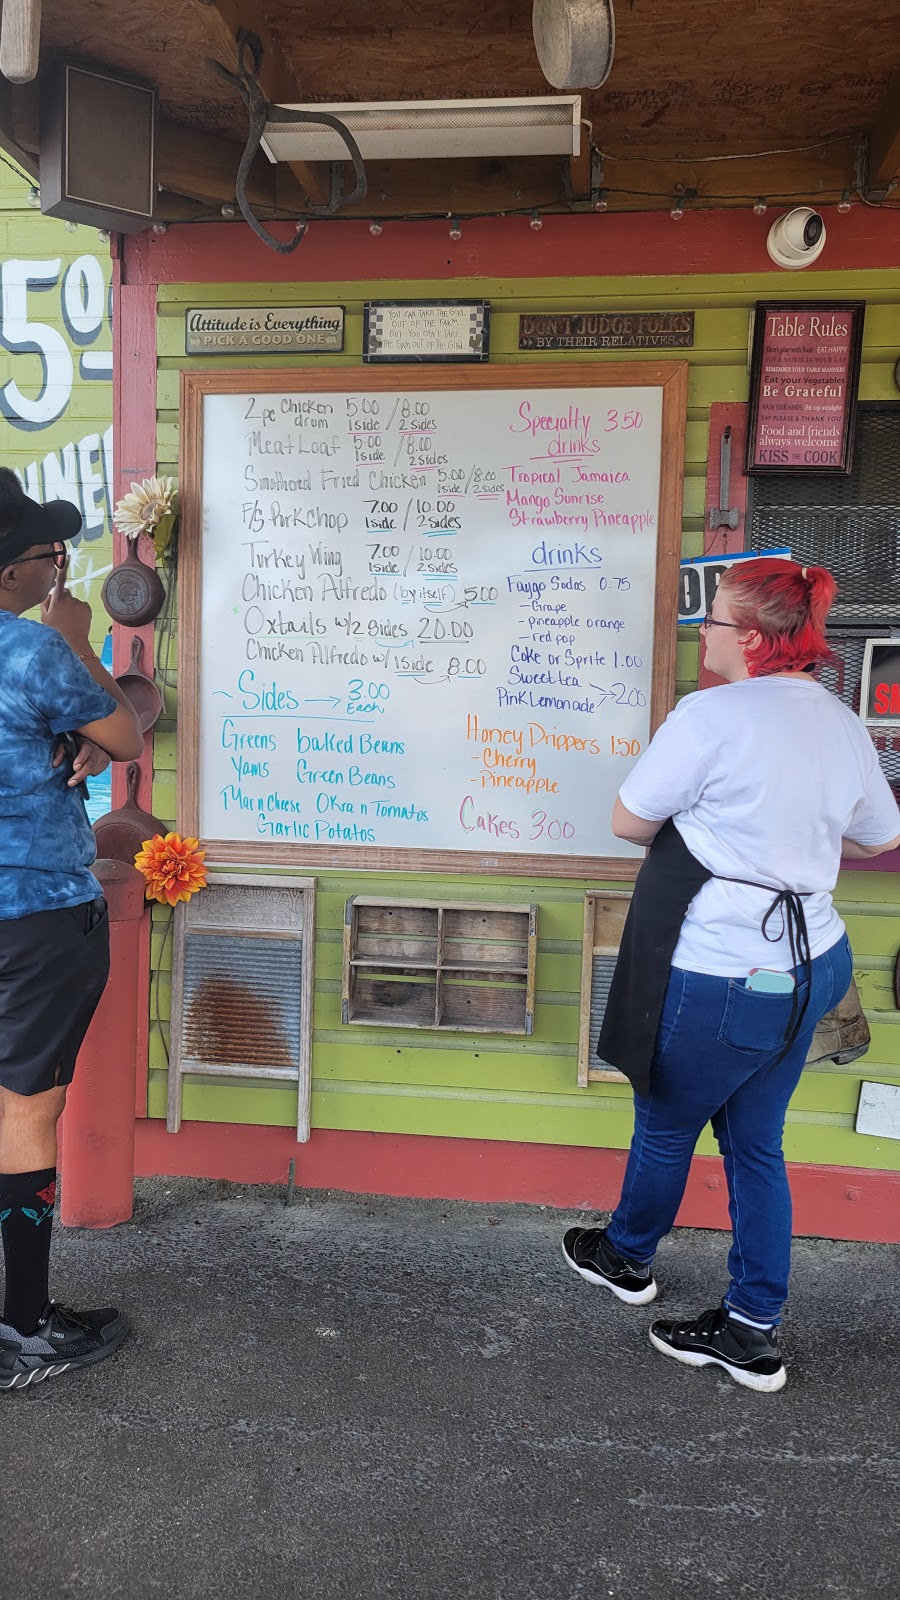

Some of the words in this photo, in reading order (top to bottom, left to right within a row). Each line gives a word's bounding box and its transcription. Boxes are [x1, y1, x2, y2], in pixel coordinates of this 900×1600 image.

[189, 313, 248, 332] Attitude
[249, 318, 261, 331] is
[264, 312, 342, 334] Everything
[391, 319, 407, 329] OUT
[410, 319, 421, 328] OF
[422, 319, 437, 328] THE
[404, 309, 416, 319] CAN
[418, 309, 434, 319] TAKE
[436, 308, 449, 318] THE
[389, 329, 403, 338] BUT
[422, 328, 441, 338] CAN'T
[443, 329, 461, 338] TAKE
[523, 317, 572, 335] DON'T
[576, 316, 633, 335] JUDGE
[638, 315, 691, 334] FOLKS
[767, 315, 805, 337] Table
[809, 315, 848, 337] Rules
[203, 335, 236, 347] PICK
[238, 335, 249, 346] A
[251, 334, 293, 346] GOOD
[295, 333, 325, 345] ONE
[382, 339, 394, 348] THE
[412, 338, 425, 348] OUT
[426, 339, 435, 349] OF
[535, 337, 552, 348] BY
[556, 336, 598, 347] THEIR
[600, 335, 676, 347] RELATIVES
[816, 346, 827, 354] EAT
[762, 385, 779, 397] Be
[784, 385, 842, 398] Grateful
[764, 375, 779, 384] Eat
[780, 377, 801, 386] your
[803, 376, 845, 386] Vegetables
[280, 398, 334, 414] Chicken
[401, 398, 430, 418] 8.00
[821, 404, 843, 412] straight
[294, 415, 329, 429] drum
[509, 400, 591, 439] Specialty
[760, 424, 785, 436] Food
[787, 425, 805, 436] and
[807, 425, 840, 437] friends
[406, 434, 432, 455] 8.00
[547, 432, 601, 457] drinks
[759, 435, 791, 448] always
[794, 436, 840, 447] welcome
[759, 449, 789, 463] KISS
[804, 450, 838, 464] COOK
[320, 469, 360, 490] Fried
[369, 470, 427, 490] Chicken
[437, 468, 466, 482] 5.00
[473, 468, 497, 482] 8.00
[501, 465, 561, 485] Tropical
[569, 465, 631, 484] Jamaica
[362, 499, 398, 514] 7.00
[416, 499, 456, 513] 10.00
[506, 488, 550, 514] Mango
[554, 487, 605, 506] Sunrise
[509, 508, 589, 533] Strawberry
[591, 508, 654, 534] Pineapple
[241, 541, 306, 580] Turkey
[308, 541, 343, 577] Wing
[365, 543, 400, 560] 7.00
[419, 546, 452, 561] 10.00
[531, 541, 603, 566] drinks
[242, 572, 314, 602] Chicken
[317, 573, 387, 601] Alfredo
[506, 574, 547, 600] Faygo
[550, 575, 587, 592] Sodas
[599, 576, 631, 591] 0.75
[244, 605, 327, 635] Oxtails
[416, 617, 474, 640] 20.00
[586, 618, 626, 633] orange
[555, 634, 576, 646] pop
[245, 638, 304, 661] Chicken
[306, 641, 368, 665] Alfredo
[447, 657, 487, 676] 8.00
[510, 644, 542, 665] Coke
[548, 654, 562, 665] or
[564, 648, 606, 669] Sprite
[613, 651, 644, 669] 1.00
[507, 665, 557, 686] Sweet
[557, 670, 583, 687] tea
[238, 669, 299, 711] Sides
[348, 679, 390, 700] 3.00
[346, 702, 385, 715] Each
[221, 719, 277, 751] Greens
[359, 733, 406, 755] Beans
[465, 713, 523, 754] Honey
[526, 722, 601, 755] Drippers
[610, 735, 642, 757] 1.50
[231, 755, 270, 782] Yams
[296, 758, 344, 784] Green
[349, 765, 396, 789] Beans
[316, 792, 356, 814] Okra
[360, 803, 368, 815] n
[256, 812, 310, 838] Garlic
[315, 819, 376, 843] Potatos
[459, 795, 520, 839] Cakes
[198, 885, 304, 914] BROADWAY
